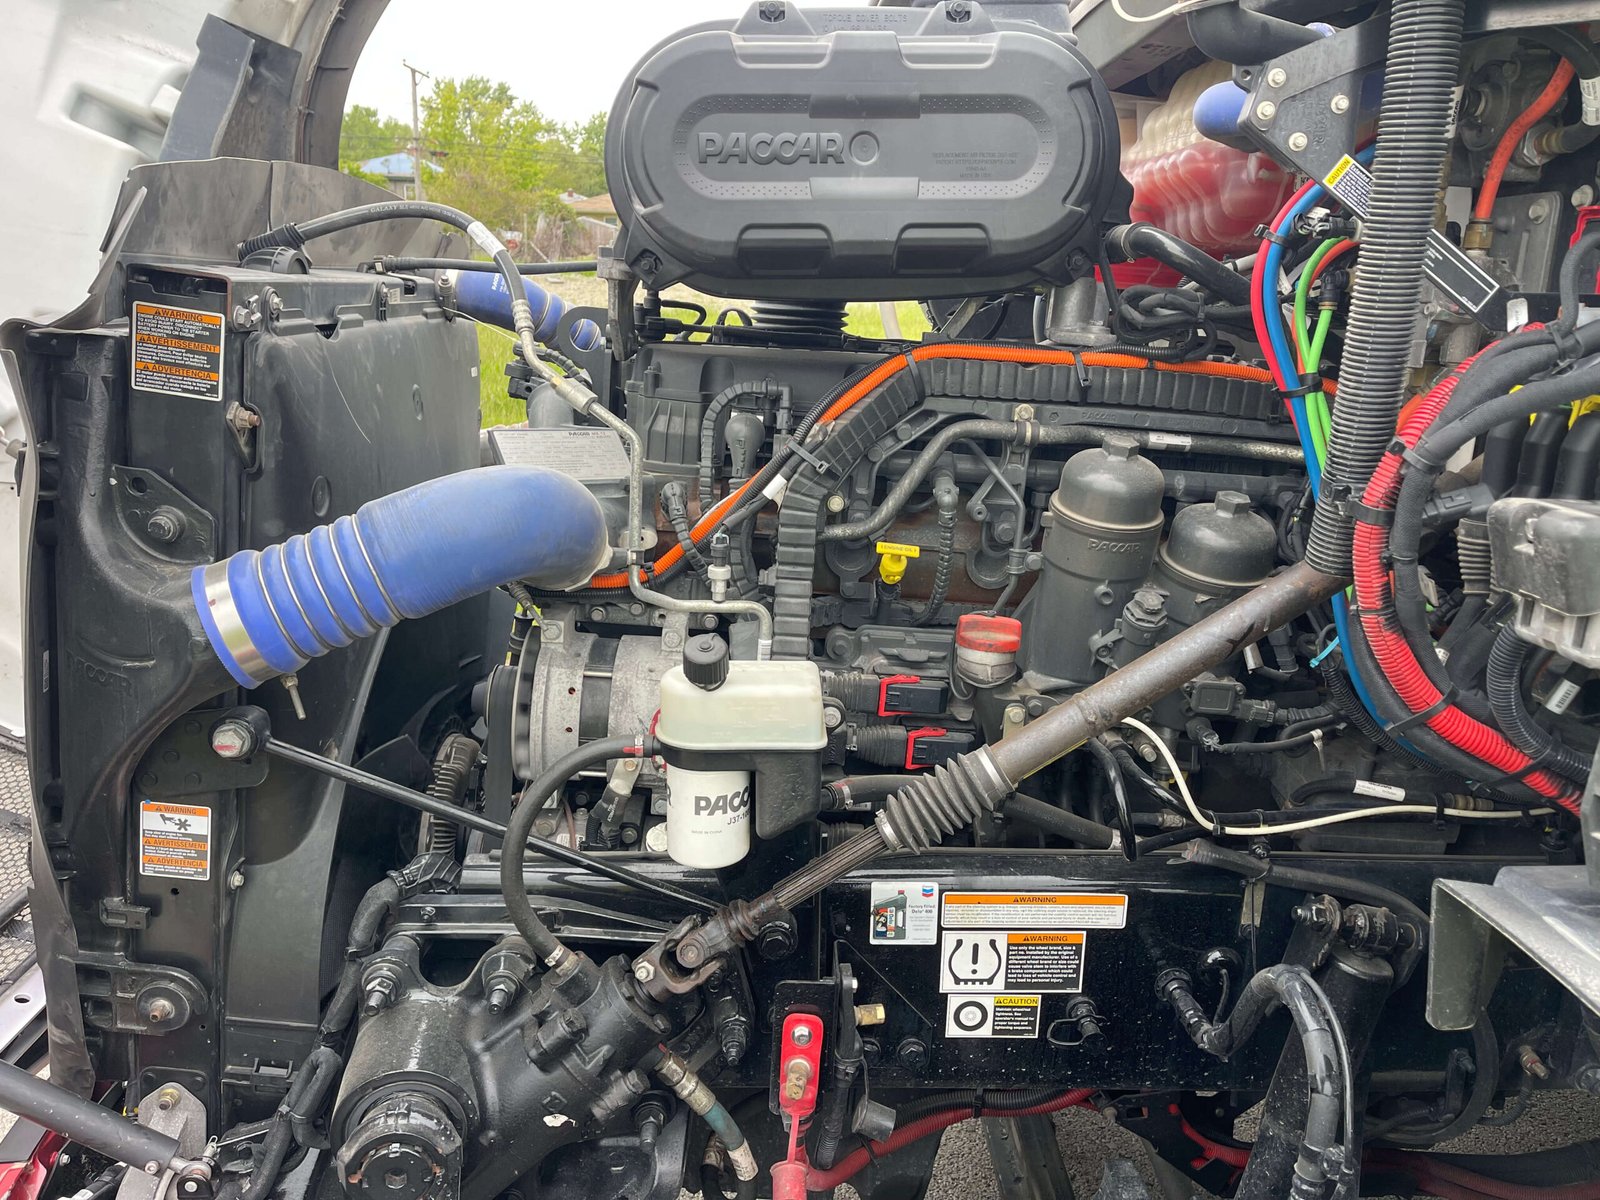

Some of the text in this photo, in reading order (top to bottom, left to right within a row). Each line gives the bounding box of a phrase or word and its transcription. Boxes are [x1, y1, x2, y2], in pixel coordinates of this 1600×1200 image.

[884, 14, 907, 22] BOLTS
[698, 132, 845, 166] PACCAR
[1328, 159, 1350, 184] CAUTION
[370, 204, 397, 213] GALAXY
[161, 308, 203, 322] WARNING
[175, 322, 202, 330] DISCONNECT
[190, 328, 209, 336] STARTER
[146, 336, 217, 352] AVERTISSEMENT
[152, 364, 211, 379] ADVERTENCIA
[1087, 538, 1141, 553] PACCAR
[163, 806, 197, 815] WARNING
[153, 839, 206, 850] AVERTISSEMENT
[156, 857, 203, 867] ADVERTENCIA
